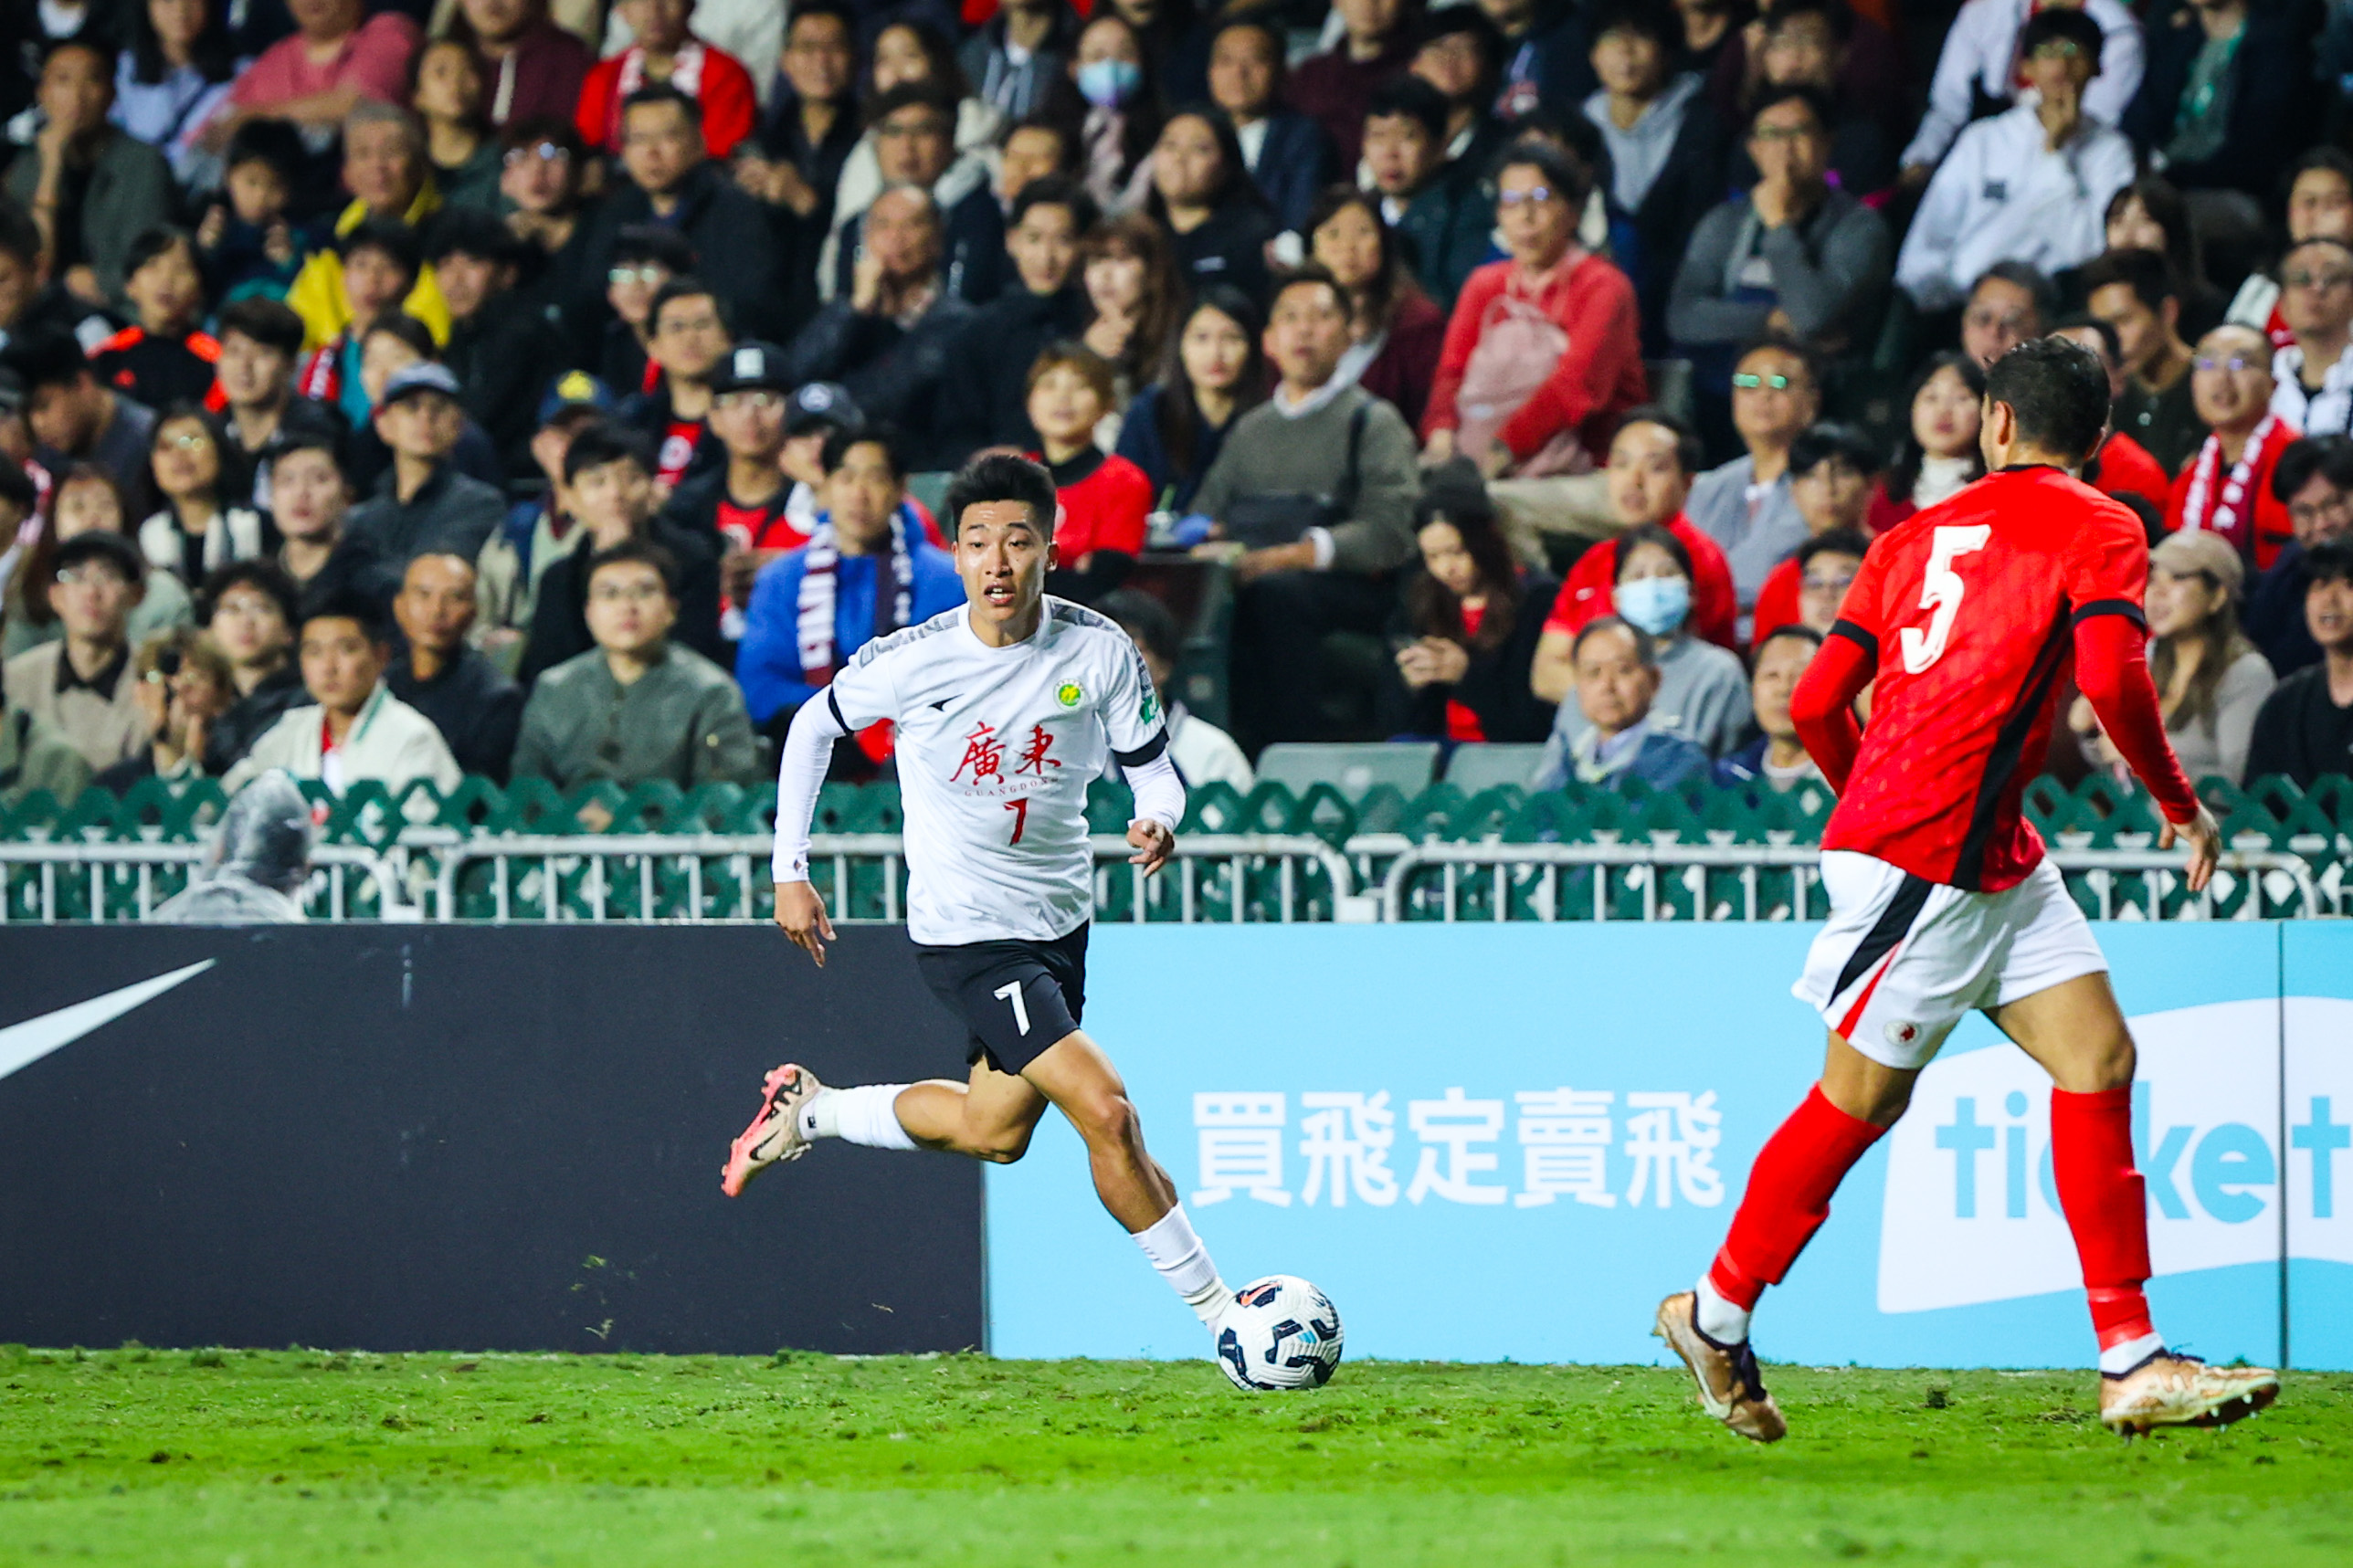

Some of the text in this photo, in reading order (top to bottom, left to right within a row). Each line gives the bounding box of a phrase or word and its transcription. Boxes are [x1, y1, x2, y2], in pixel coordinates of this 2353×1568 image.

[1900, 523, 1992, 675] 5
[949, 721, 1061, 786] 廣東
[1003, 797, 1029, 847] 7
[993, 979, 1031, 1037] 7
[1190, 1087, 1725, 1209] 買飛定賣飛
[1935, 1080, 2351, 1225] tiket
